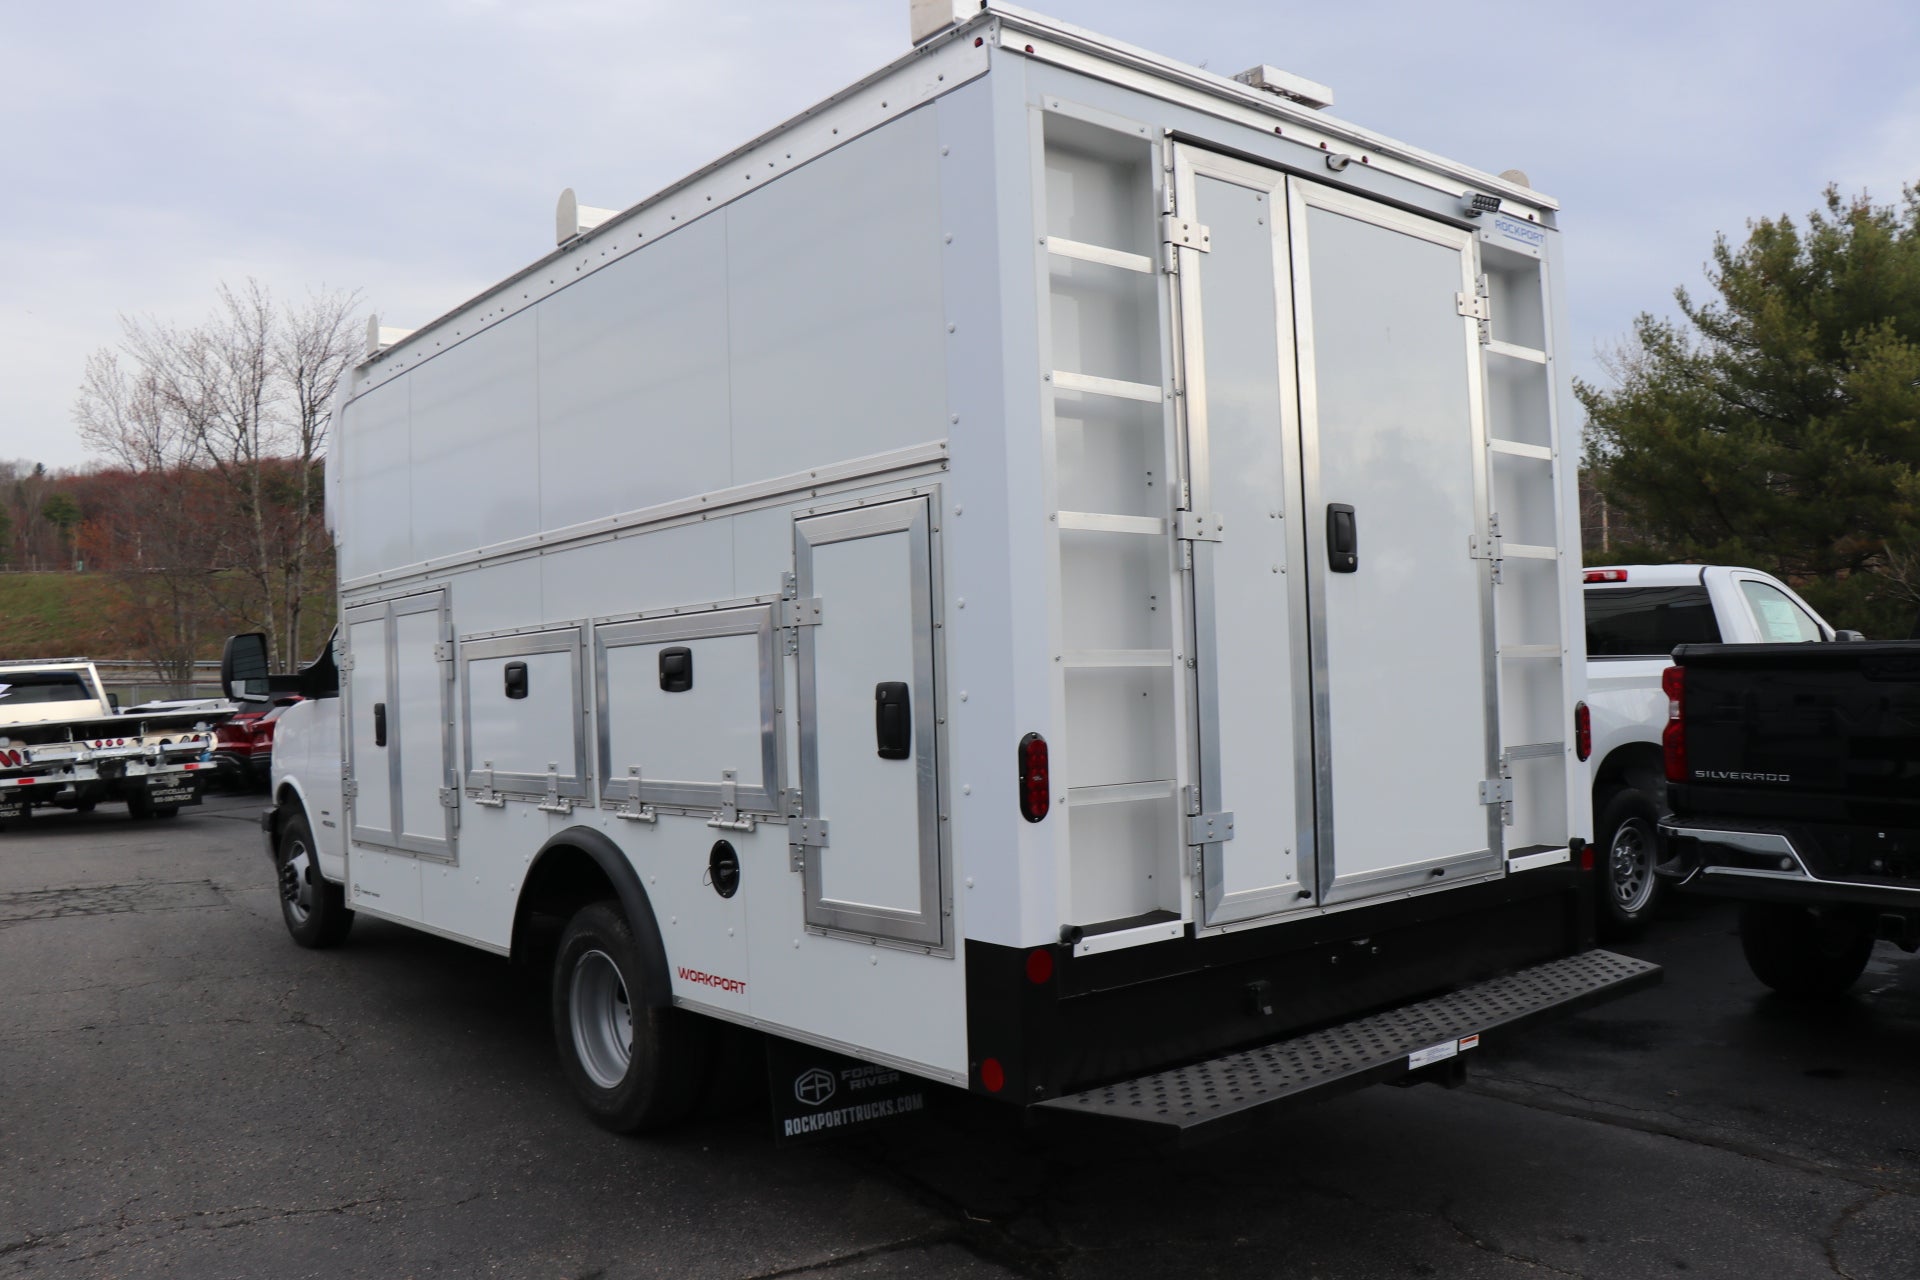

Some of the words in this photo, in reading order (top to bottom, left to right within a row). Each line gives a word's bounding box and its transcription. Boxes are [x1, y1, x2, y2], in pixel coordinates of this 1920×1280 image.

[1494, 219, 1545, 243] ROCKPORT
[1695, 770, 1791, 782] SILVERADO
[677, 965, 747, 994] WORKPORT
[849, 1072, 900, 1091] RIVER
[784, 1093, 923, 1136] ROCKPORTTRUCKS.COM
